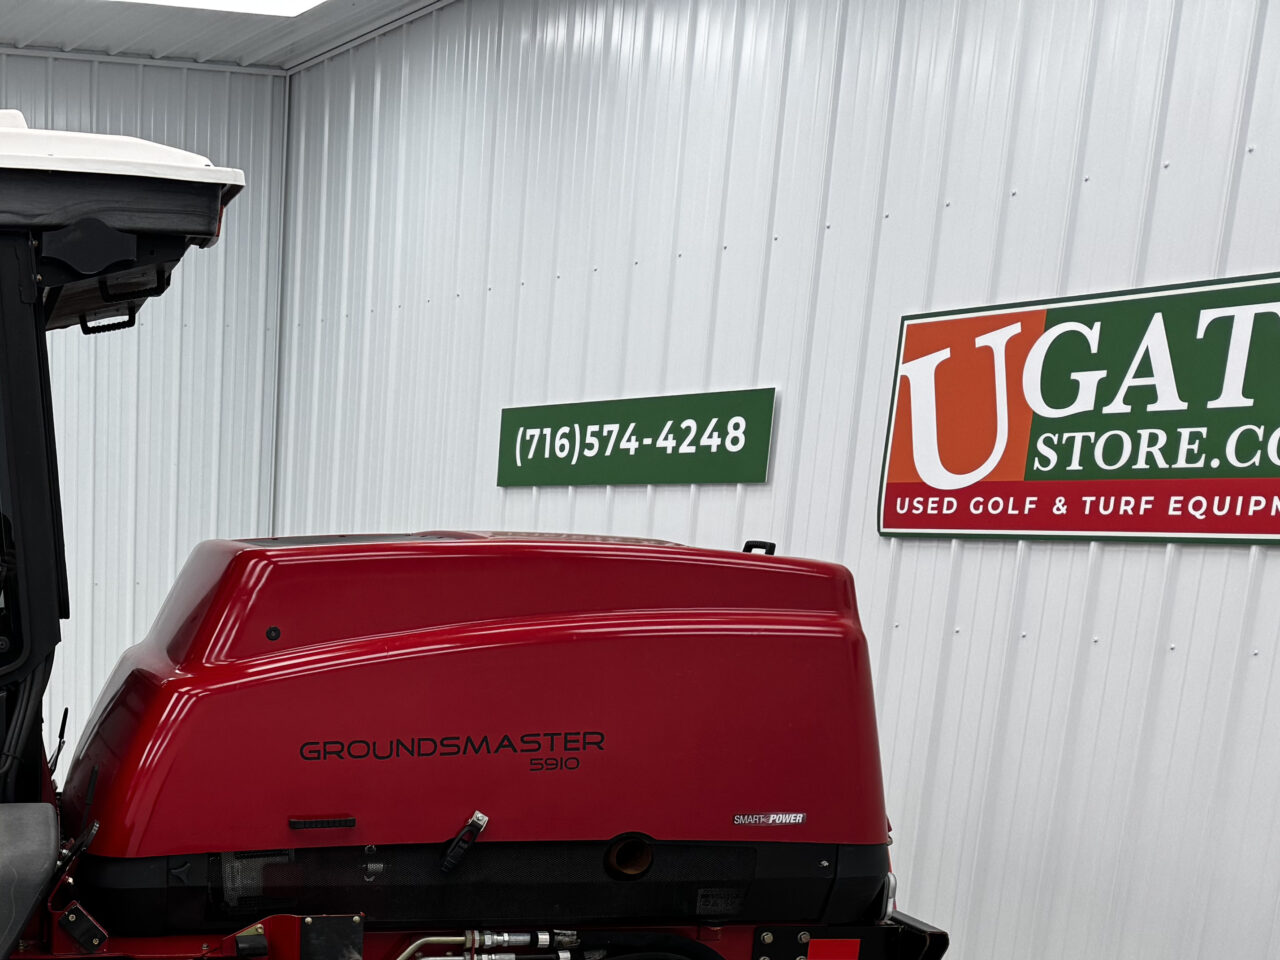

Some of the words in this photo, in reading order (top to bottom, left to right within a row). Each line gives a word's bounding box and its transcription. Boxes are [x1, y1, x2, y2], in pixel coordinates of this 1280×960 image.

[515, 415, 747, 467] (716)574-4248
[896, 497, 958, 514] USED
[969, 496, 1038, 515] GOLF
[1052, 496, 1068, 515] &
[1082, 496, 1155, 515] TURF
[300, 731, 606, 761] GROUNDSMASTER
[529, 757, 580, 771] 5910
